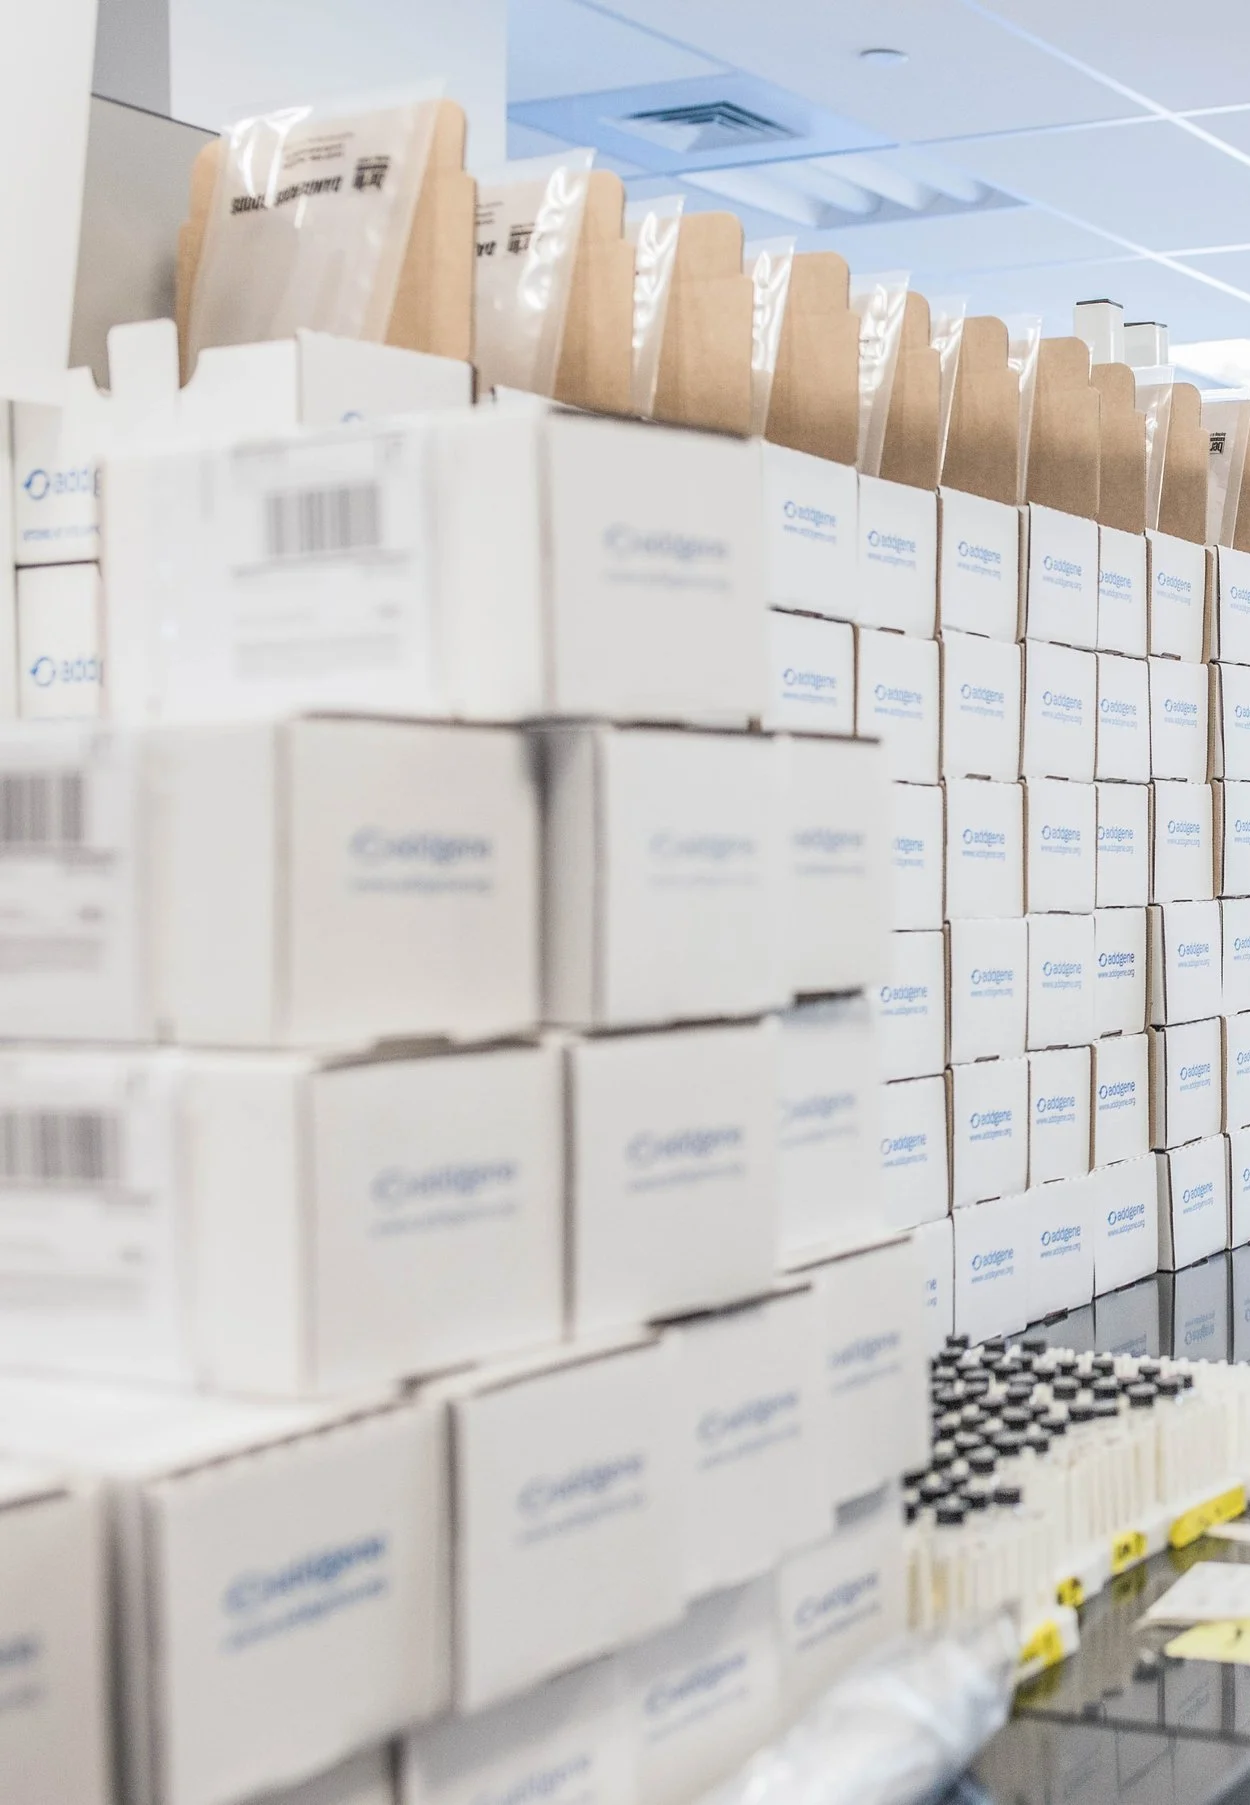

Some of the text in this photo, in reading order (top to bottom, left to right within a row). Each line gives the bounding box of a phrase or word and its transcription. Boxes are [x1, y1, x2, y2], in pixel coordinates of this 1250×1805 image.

[1053, 558, 1082, 577] addgene
[1107, 952, 1135, 967] addgene
[1052, 962, 1081, 977] addgene
[1098, 969, 1135, 980] www.addgene.org
[1188, 1063, 1210, 1078] addgene
[1108, 1080, 1135, 1097] addgene
[1047, 1095, 1075, 1112] addgene
[1190, 1182, 1213, 1198] addgene
[1117, 1203, 1145, 1221] addgene
[1051, 1225, 1081, 1243] addgene
[982, 1248, 1014, 1267] addgene
